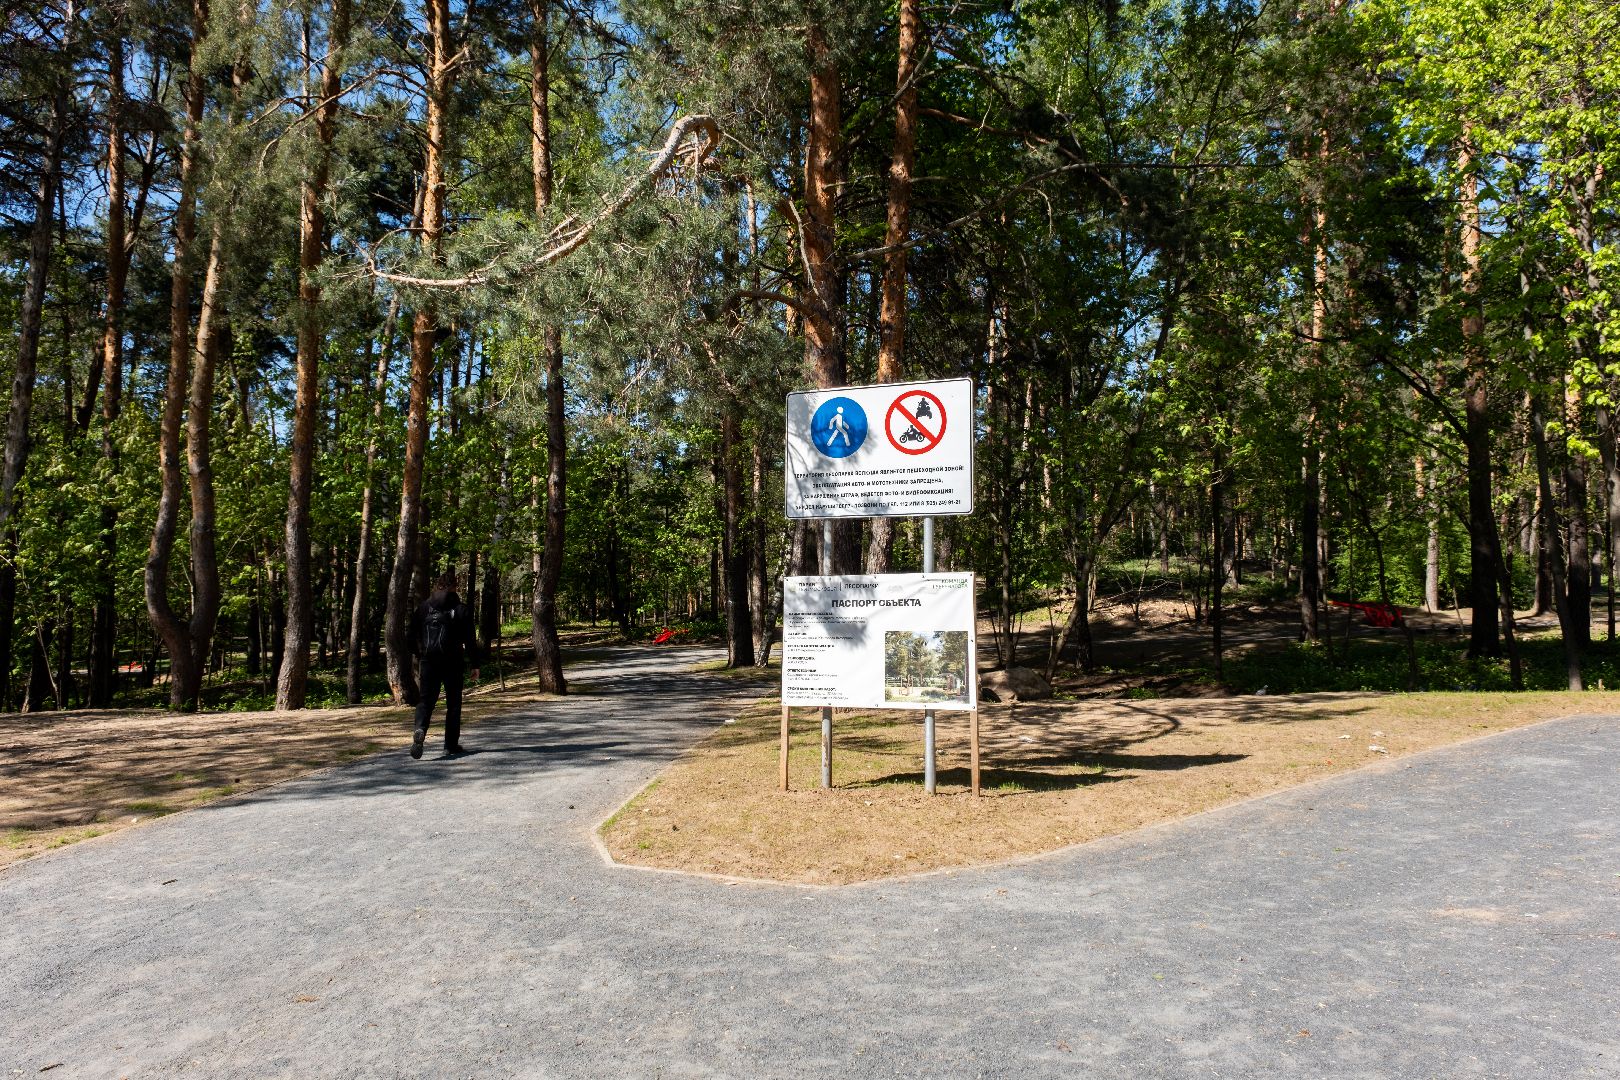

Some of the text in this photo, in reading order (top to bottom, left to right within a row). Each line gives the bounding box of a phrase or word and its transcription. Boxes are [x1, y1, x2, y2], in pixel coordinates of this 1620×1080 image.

[906, 466, 943, 474] ПЕШЕХОДНОЙ
[831, 598, 922, 608] ПАСПОРТ ОБЪЕКТА
